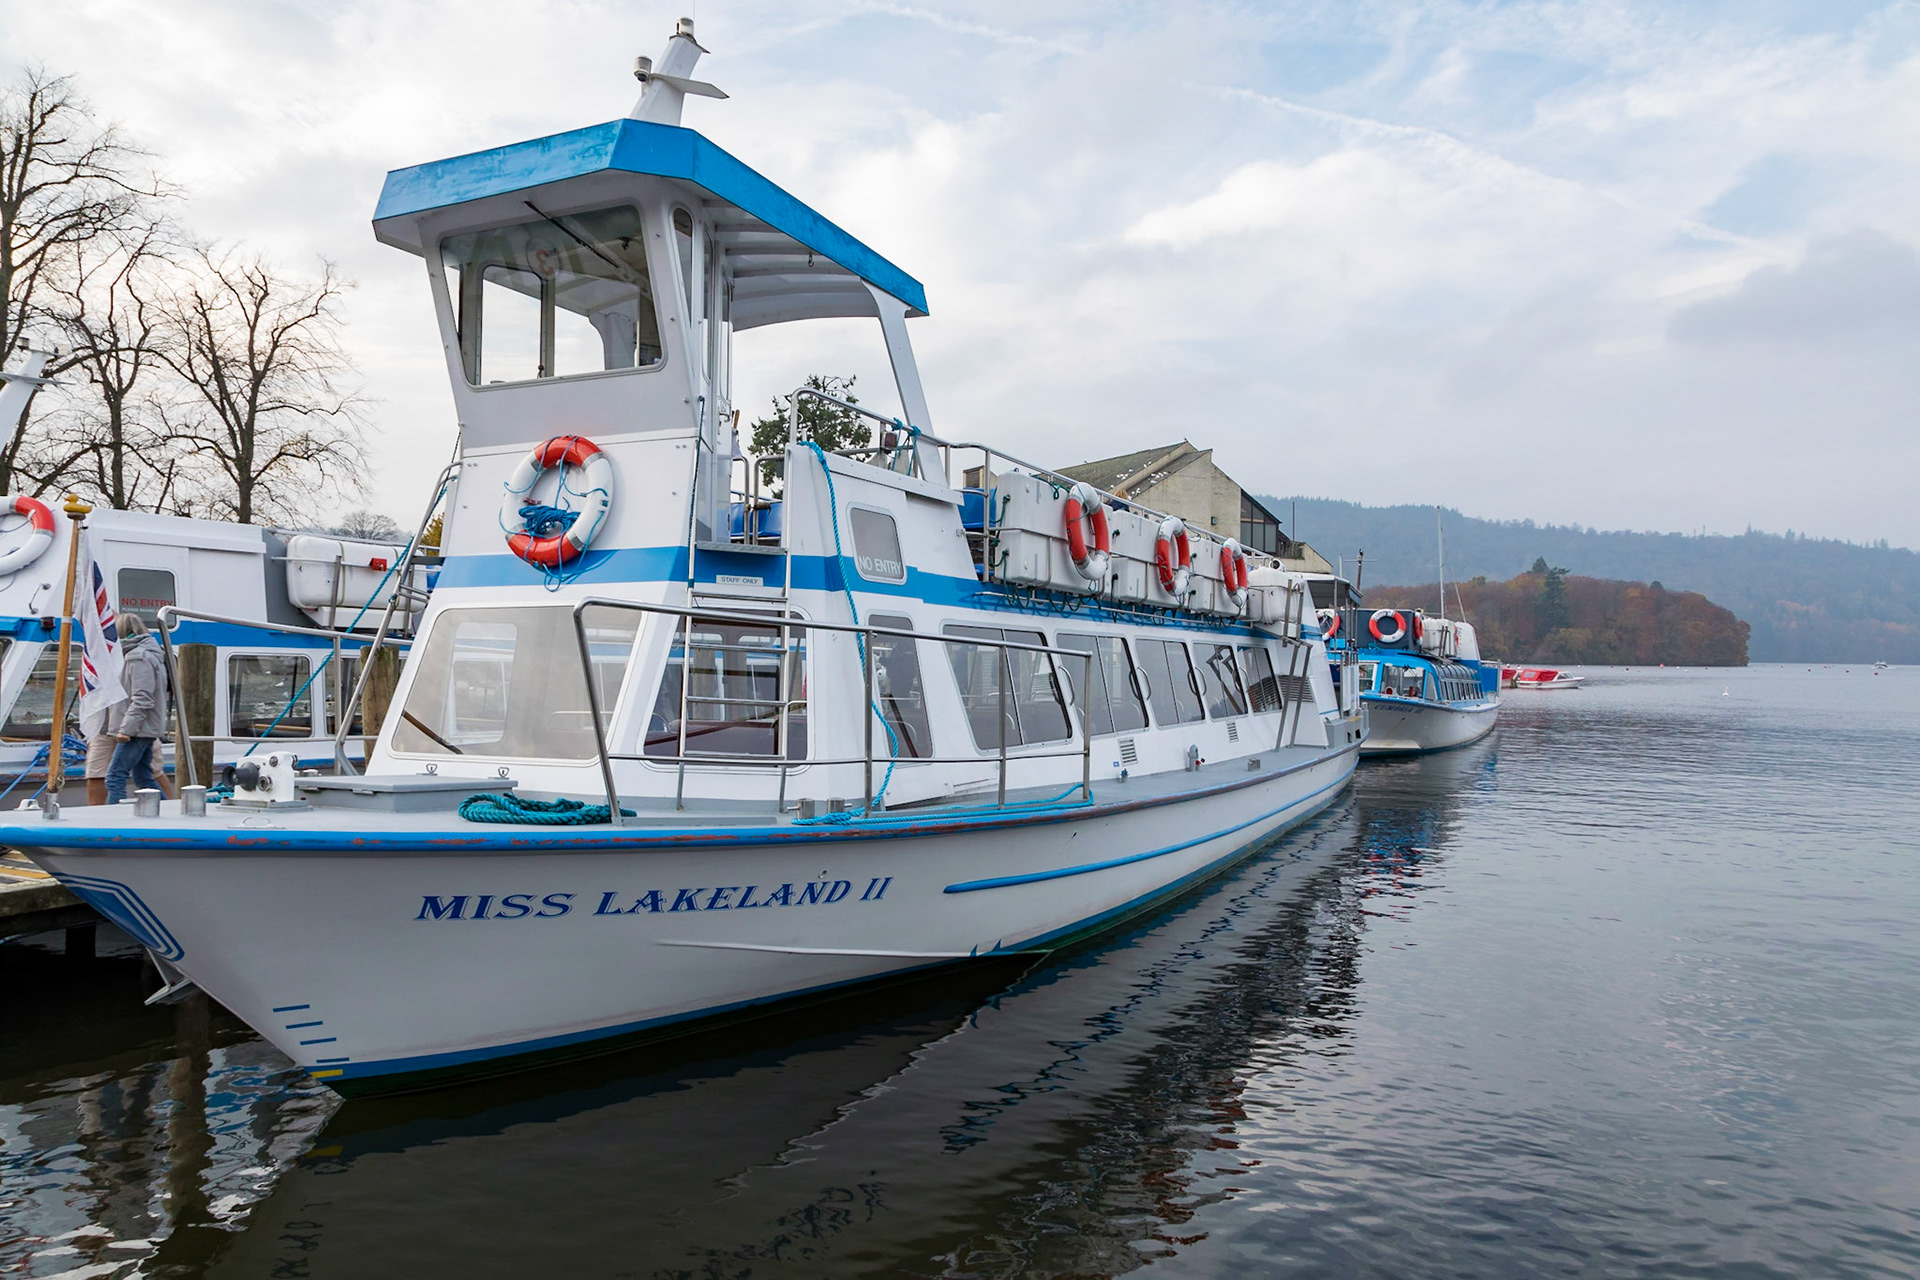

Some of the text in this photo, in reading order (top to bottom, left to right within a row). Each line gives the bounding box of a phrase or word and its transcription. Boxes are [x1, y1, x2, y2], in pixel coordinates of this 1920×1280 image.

[858, 556, 902, 575] NO ENTRY
[121, 597, 174, 608] NO ENTRY
[413, 876, 895, 921] MISS LAKELAND II
